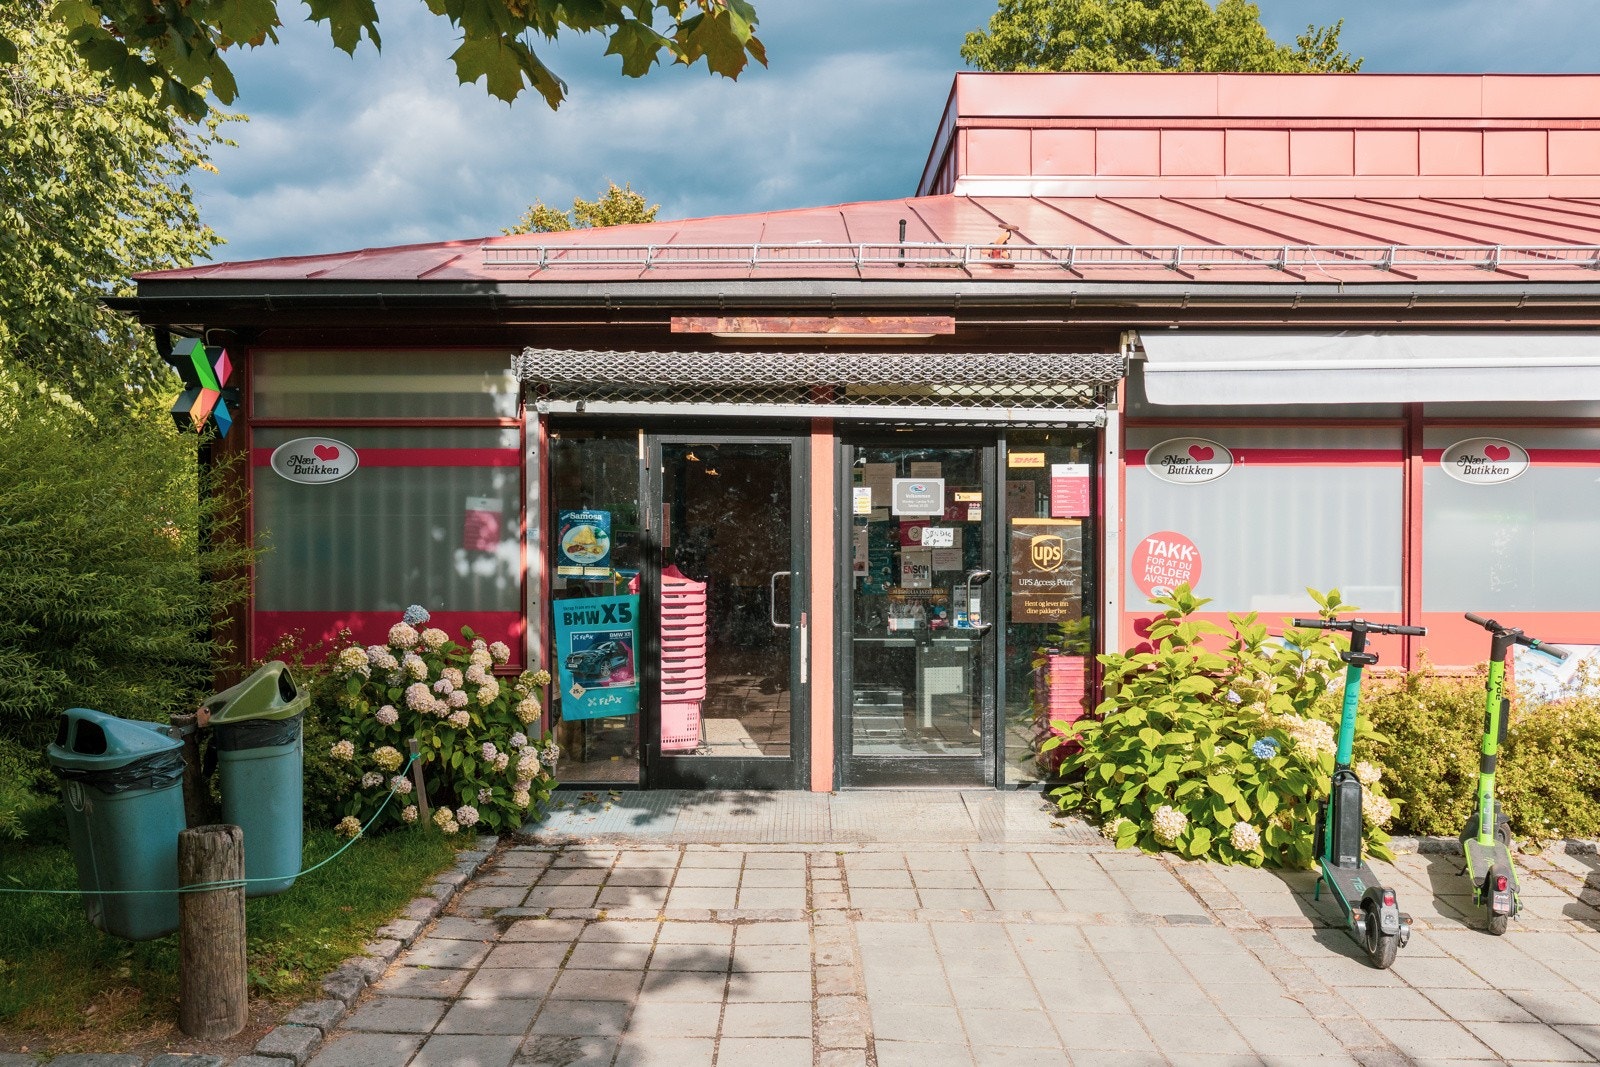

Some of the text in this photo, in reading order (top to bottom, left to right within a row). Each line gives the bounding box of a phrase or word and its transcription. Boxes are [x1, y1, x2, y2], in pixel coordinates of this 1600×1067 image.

[286, 454, 317, 467] Nær
[1160, 454, 1191, 467] Nær
[1456, 454, 1487, 467] Nær
[293, 464, 340, 475] Butikken
[1167, 465, 1214, 475] Butikken
[1463, 465, 1510, 475] Butikken
[569, 512, 603, 520] Samosa
[1034, 546, 1061, 566] ups
[1146, 556, 1192, 571] FOR AT DU
[1145, 565, 1191, 580] HOLDER
[563, 602, 633, 626] BMW X5
[1494, 675, 1503, 701] ryde
[599, 694, 622, 706] FLAX
